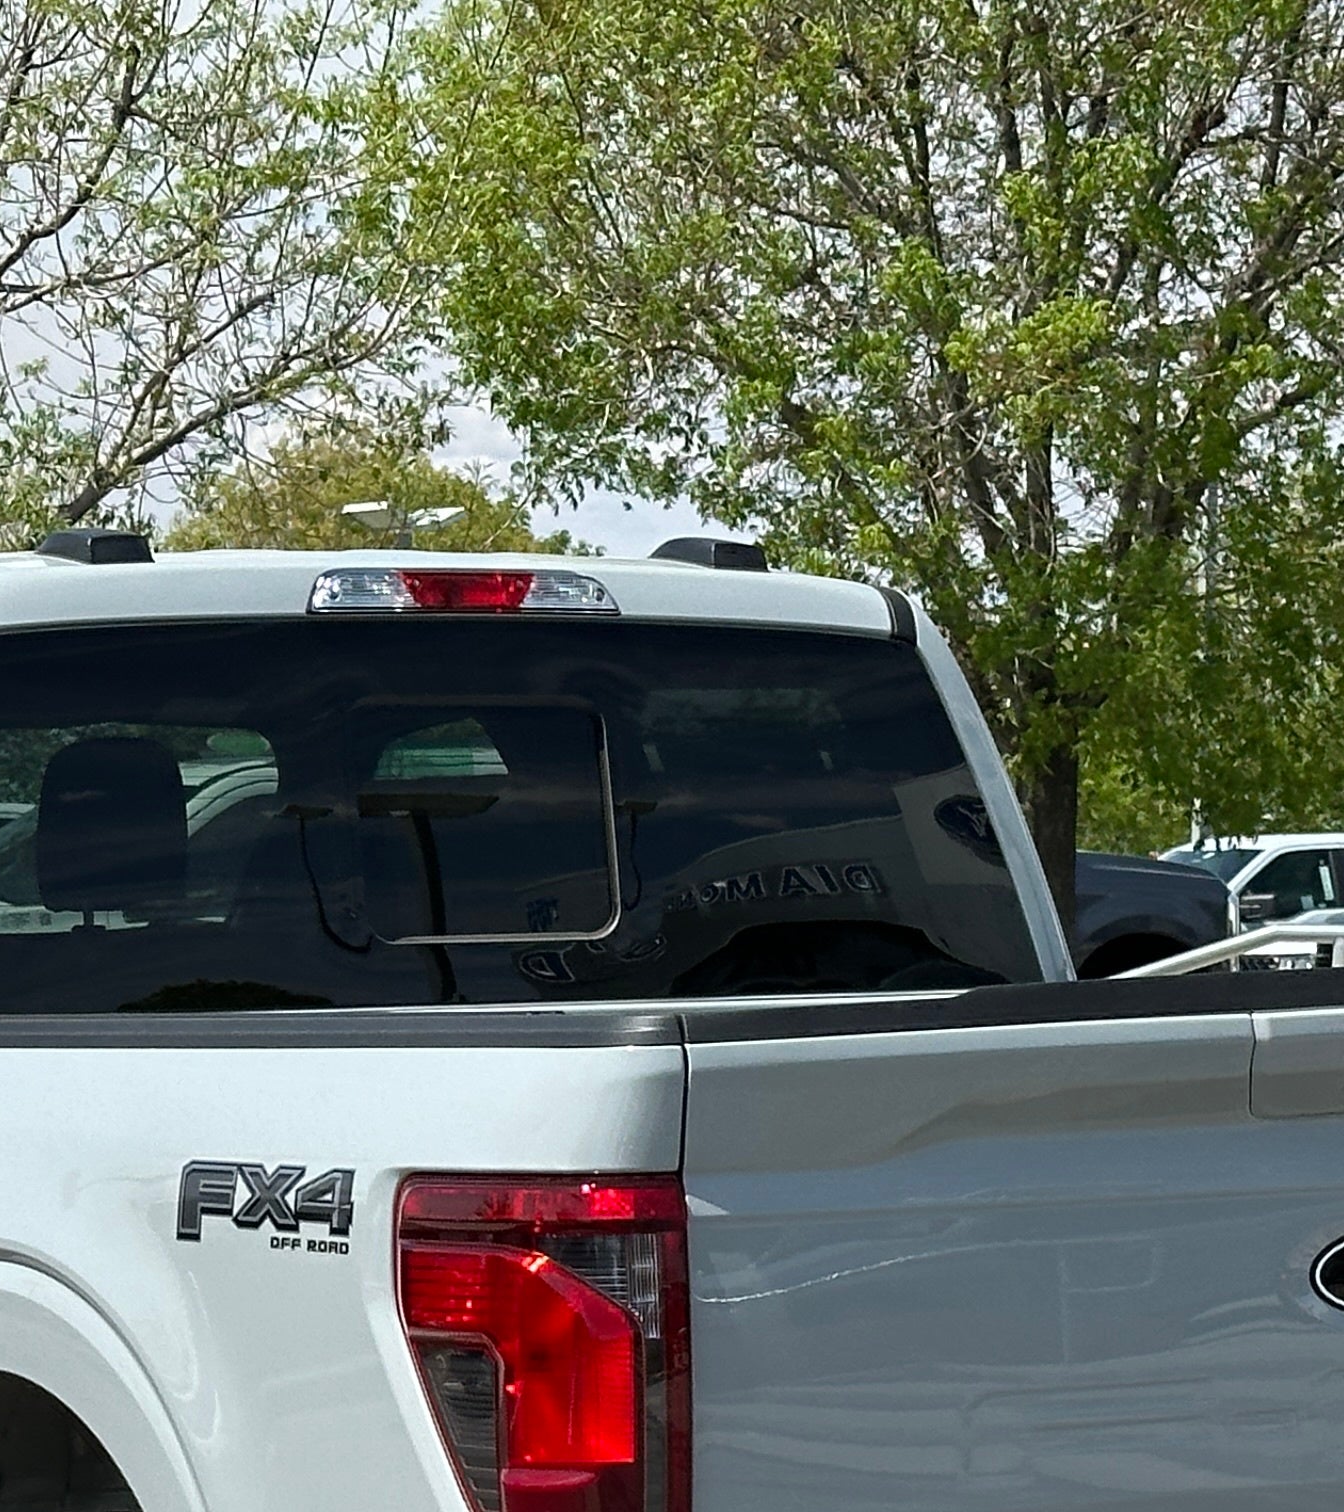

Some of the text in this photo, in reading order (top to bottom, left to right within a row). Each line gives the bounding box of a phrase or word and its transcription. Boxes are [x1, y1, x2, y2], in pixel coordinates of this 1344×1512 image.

[175, 1159, 357, 1242] FX4
[269, 1235, 350, 1256] OFF ROAD
